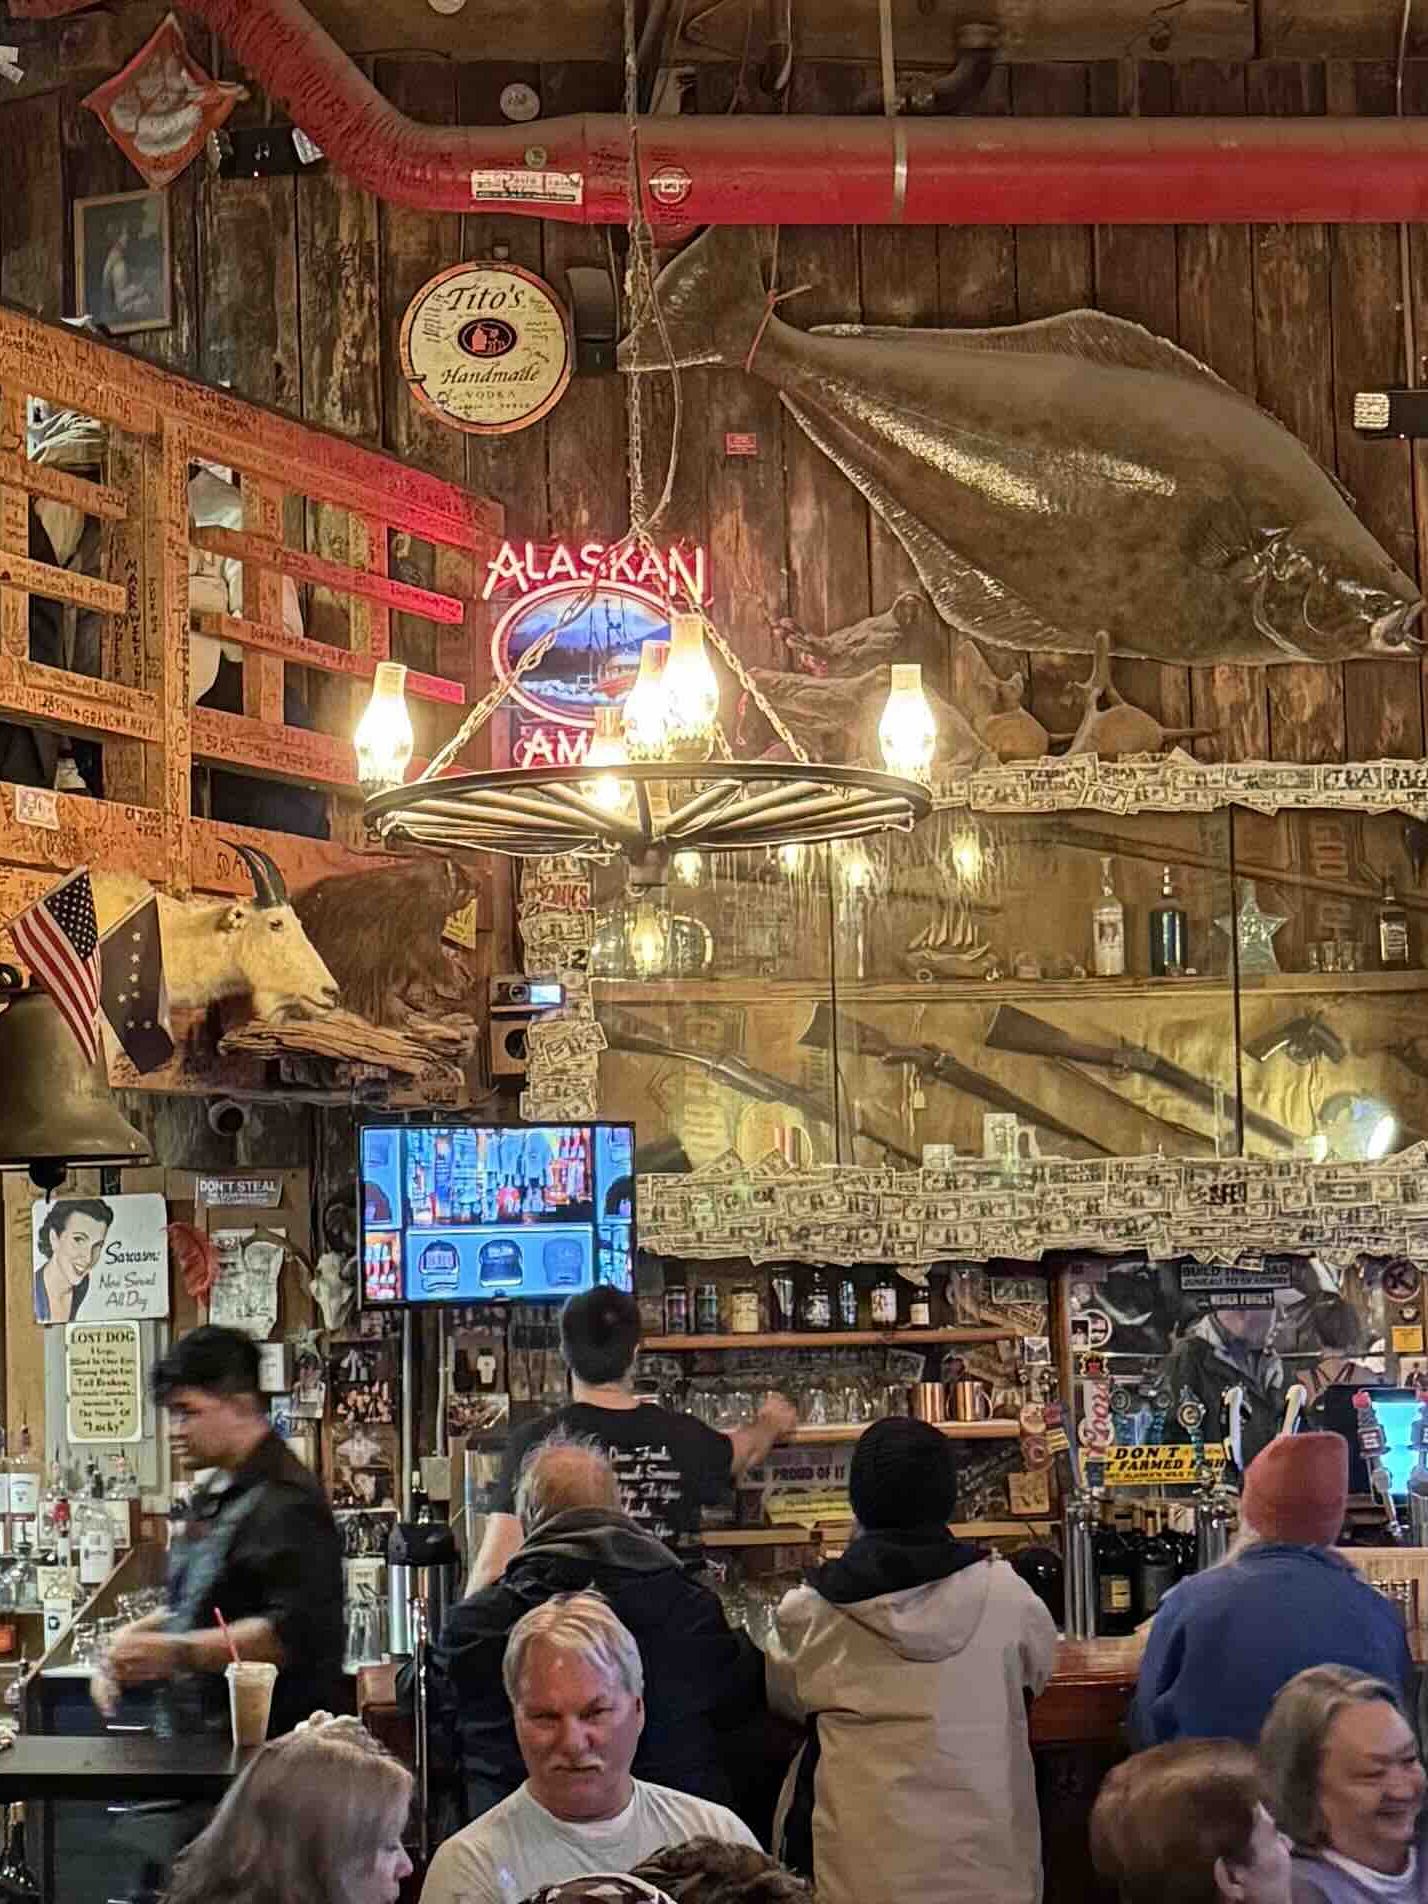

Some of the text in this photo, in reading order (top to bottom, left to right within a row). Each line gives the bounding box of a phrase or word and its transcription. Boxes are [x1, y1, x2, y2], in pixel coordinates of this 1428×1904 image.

[447, 283, 526, 312] Tito's
[441, 361, 541, 386] Handmade
[465, 390, 517, 401] VODKA
[481, 541, 706, 604] ALASKAN
[199, 1179, 277, 1193] DON'T STEAL
[70, 1330, 136, 1344] LOST DOG
[772, 1465, 814, 1482] PROUD
[816, 1465, 831, 1481] OF
[834, 1464, 846, 1481] IT
